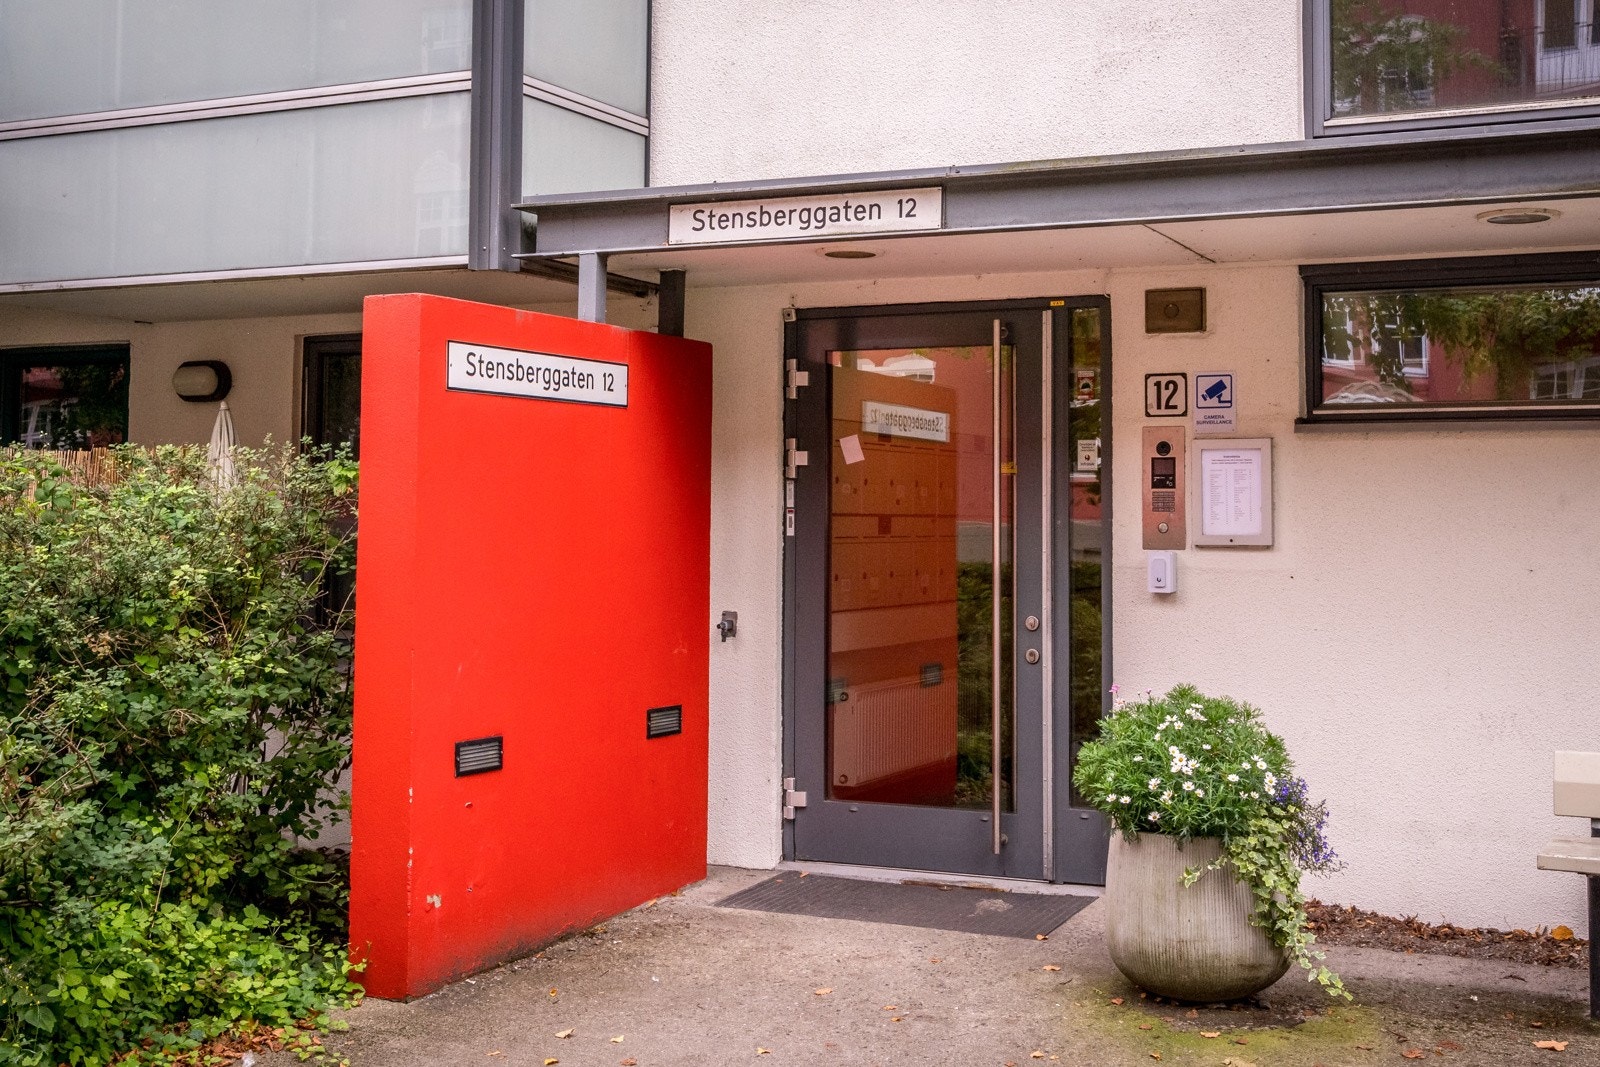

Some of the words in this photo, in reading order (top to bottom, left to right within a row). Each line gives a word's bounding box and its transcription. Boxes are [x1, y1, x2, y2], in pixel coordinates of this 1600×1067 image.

[692, 200, 882, 232] Stensberggaten
[897, 198, 917, 219] 12
[466, 352, 594, 391] Stensberggaten
[603, 372, 614, 392] 12
[1154, 380, 1179, 410] 12
